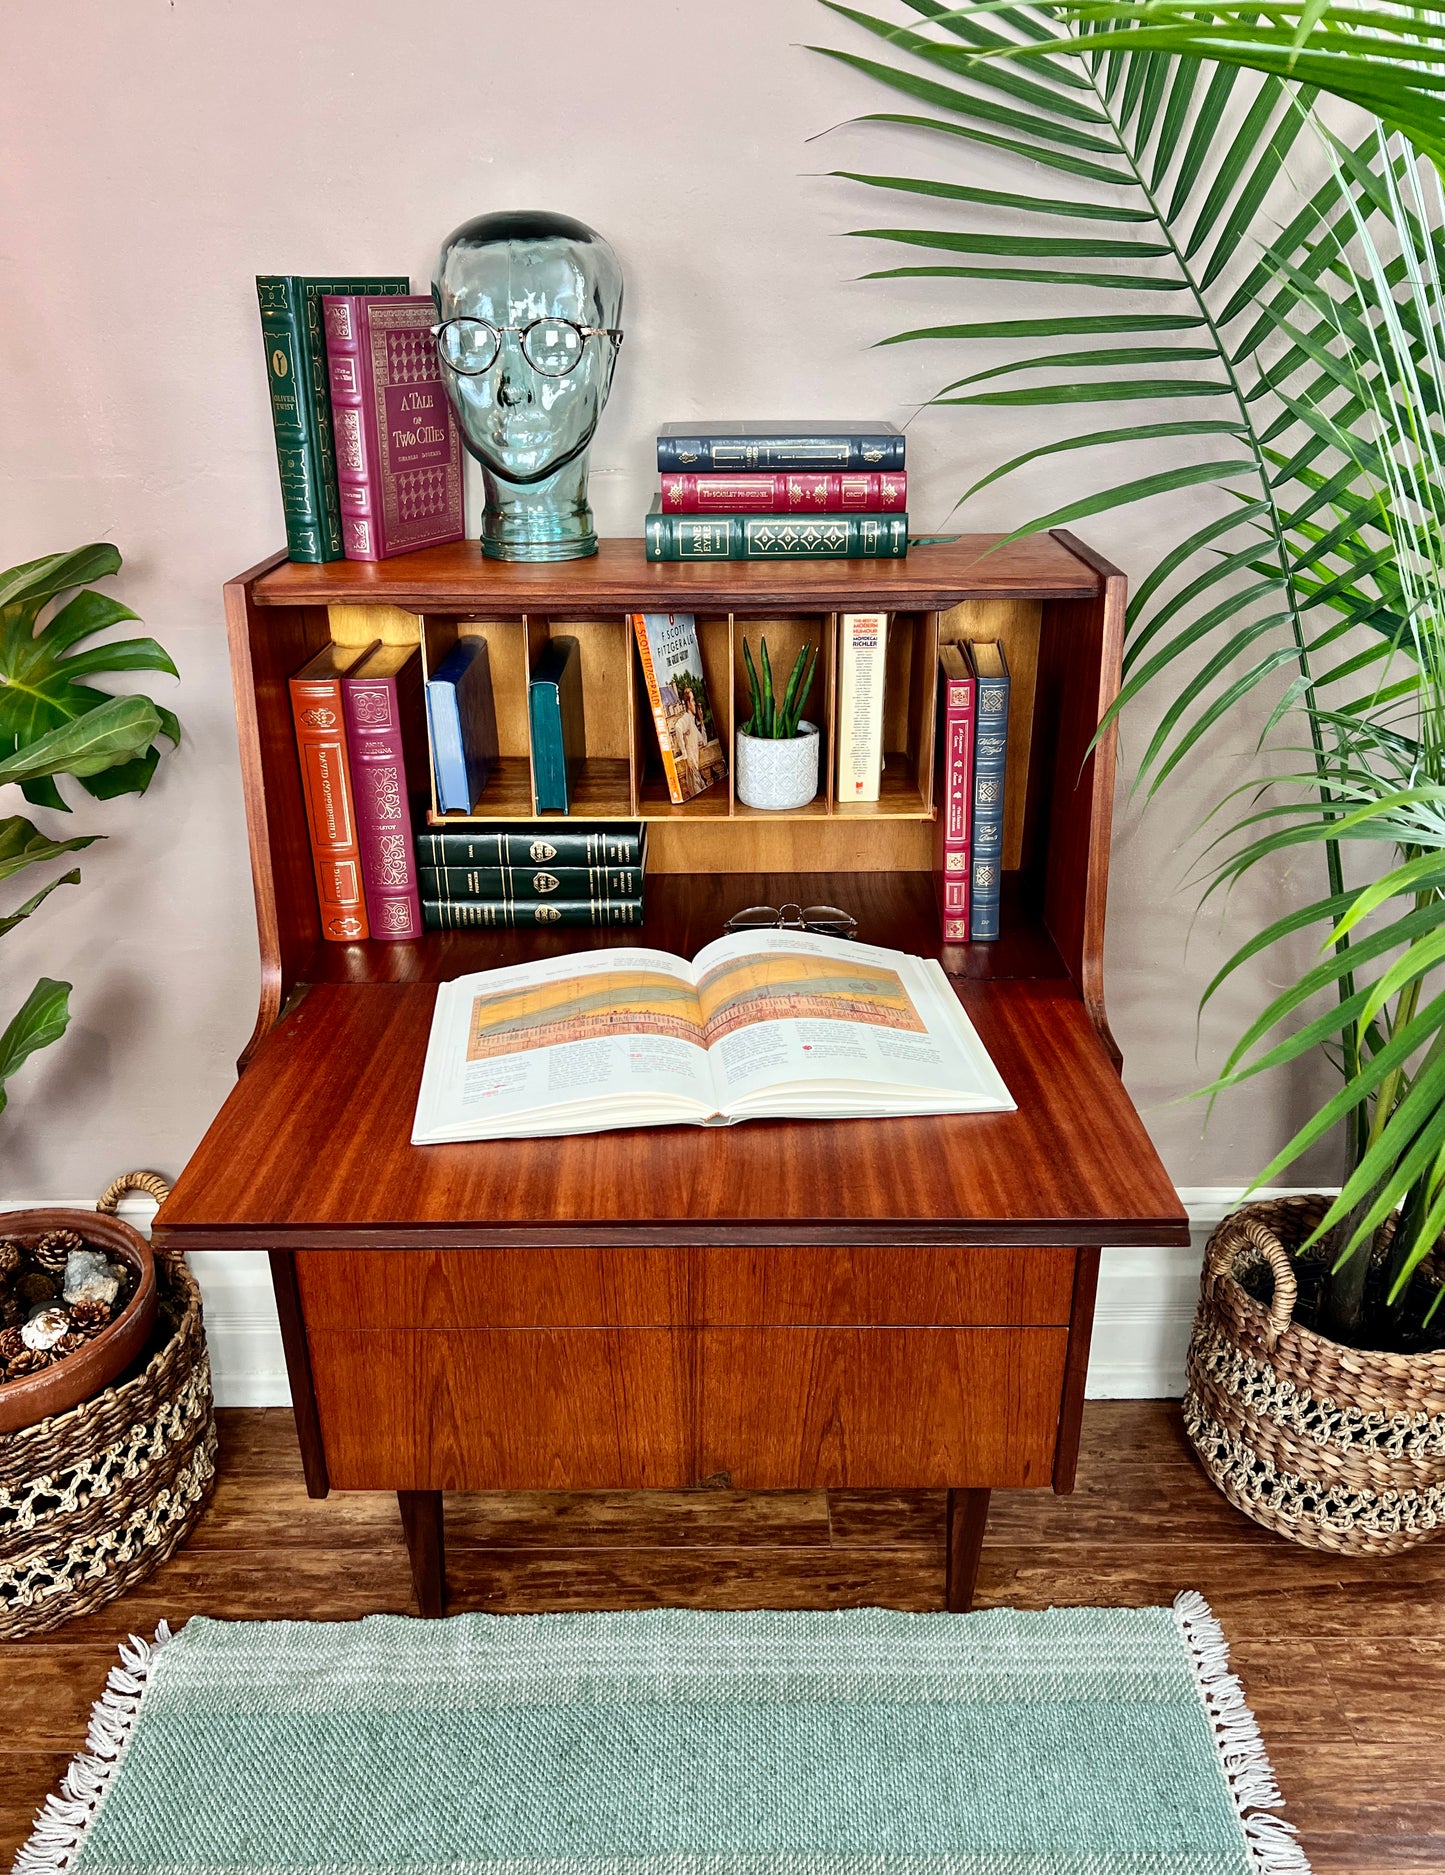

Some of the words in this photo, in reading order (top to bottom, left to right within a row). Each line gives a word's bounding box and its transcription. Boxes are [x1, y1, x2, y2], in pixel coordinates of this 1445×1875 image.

[400, 396, 410, 411] A
[712, 490, 737, 498] SCARLET
[693, 525, 703, 553] JANE
[703, 525, 712, 552] EYRE
[666, 624, 686, 640] SCOTT
[657, 634, 694, 658] FITZGERALD
[637, 629, 650, 654] SCOTT
[644, 658, 660, 705] FITZGERALD
[318, 752, 329, 779] DAVID
[333, 868, 342, 899] Dickens
